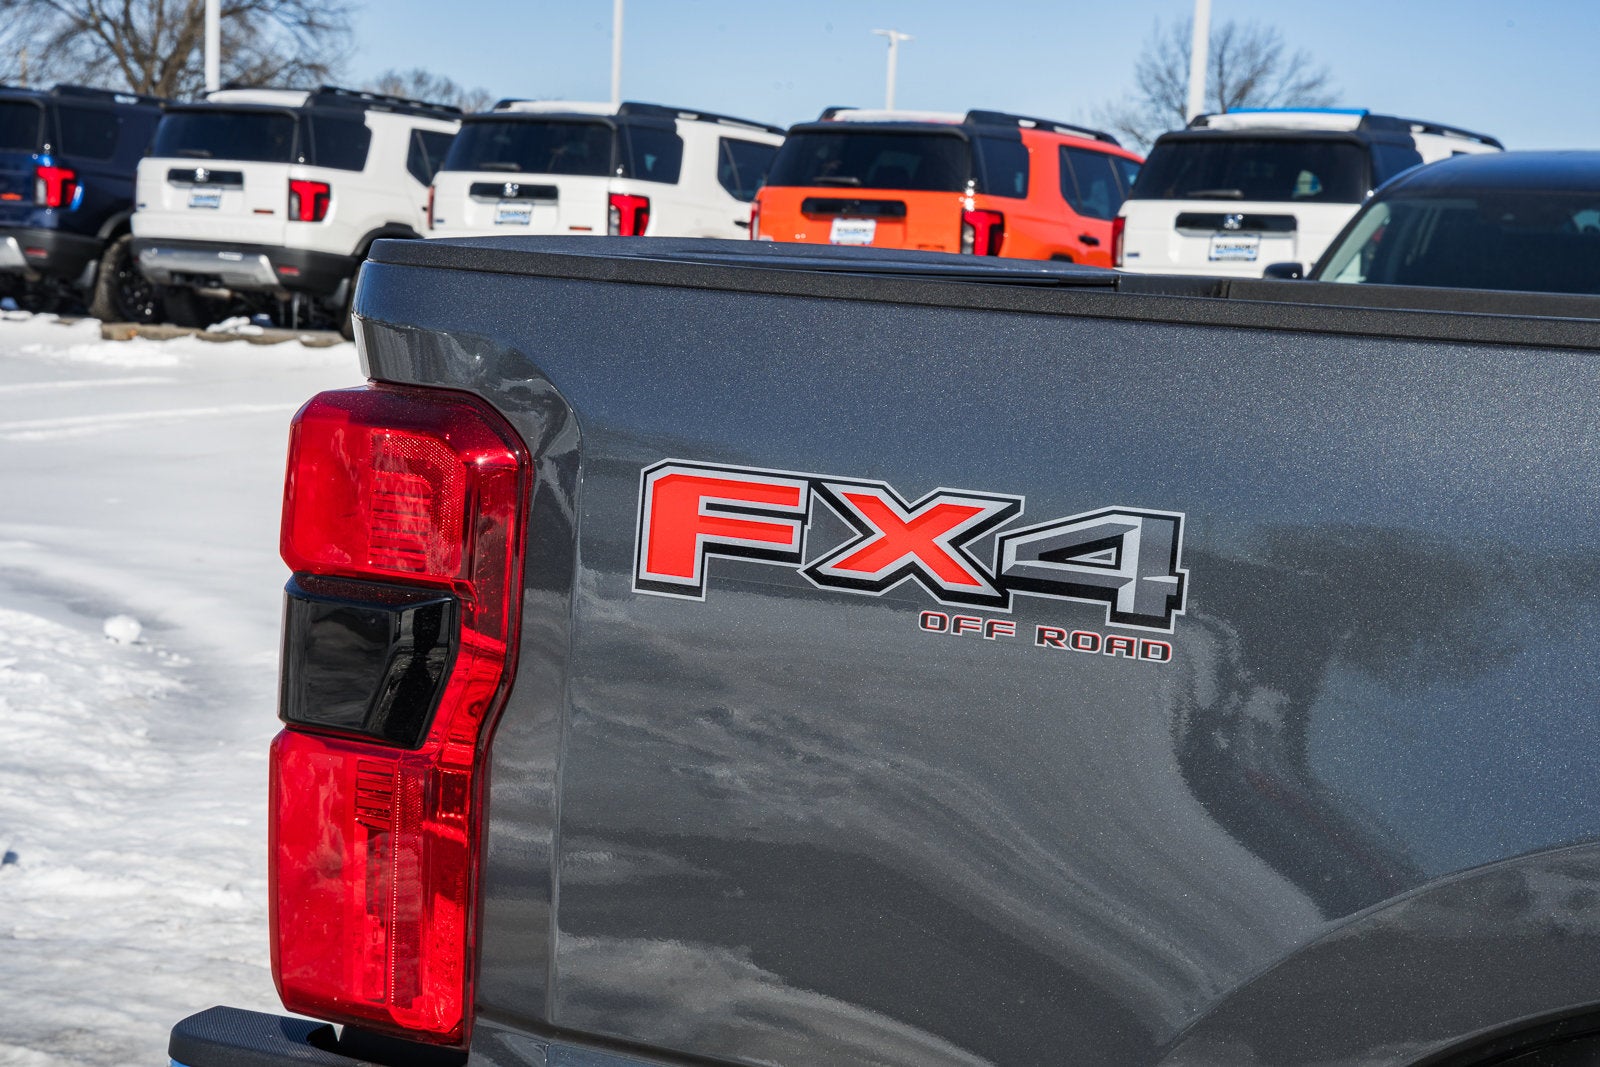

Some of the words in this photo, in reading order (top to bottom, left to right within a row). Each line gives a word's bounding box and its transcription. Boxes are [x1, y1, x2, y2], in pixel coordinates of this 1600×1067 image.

[632, 458, 1190, 633] FX4
[919, 610, 1016, 640] OFF
[1035, 625, 1172, 663] ROAD
